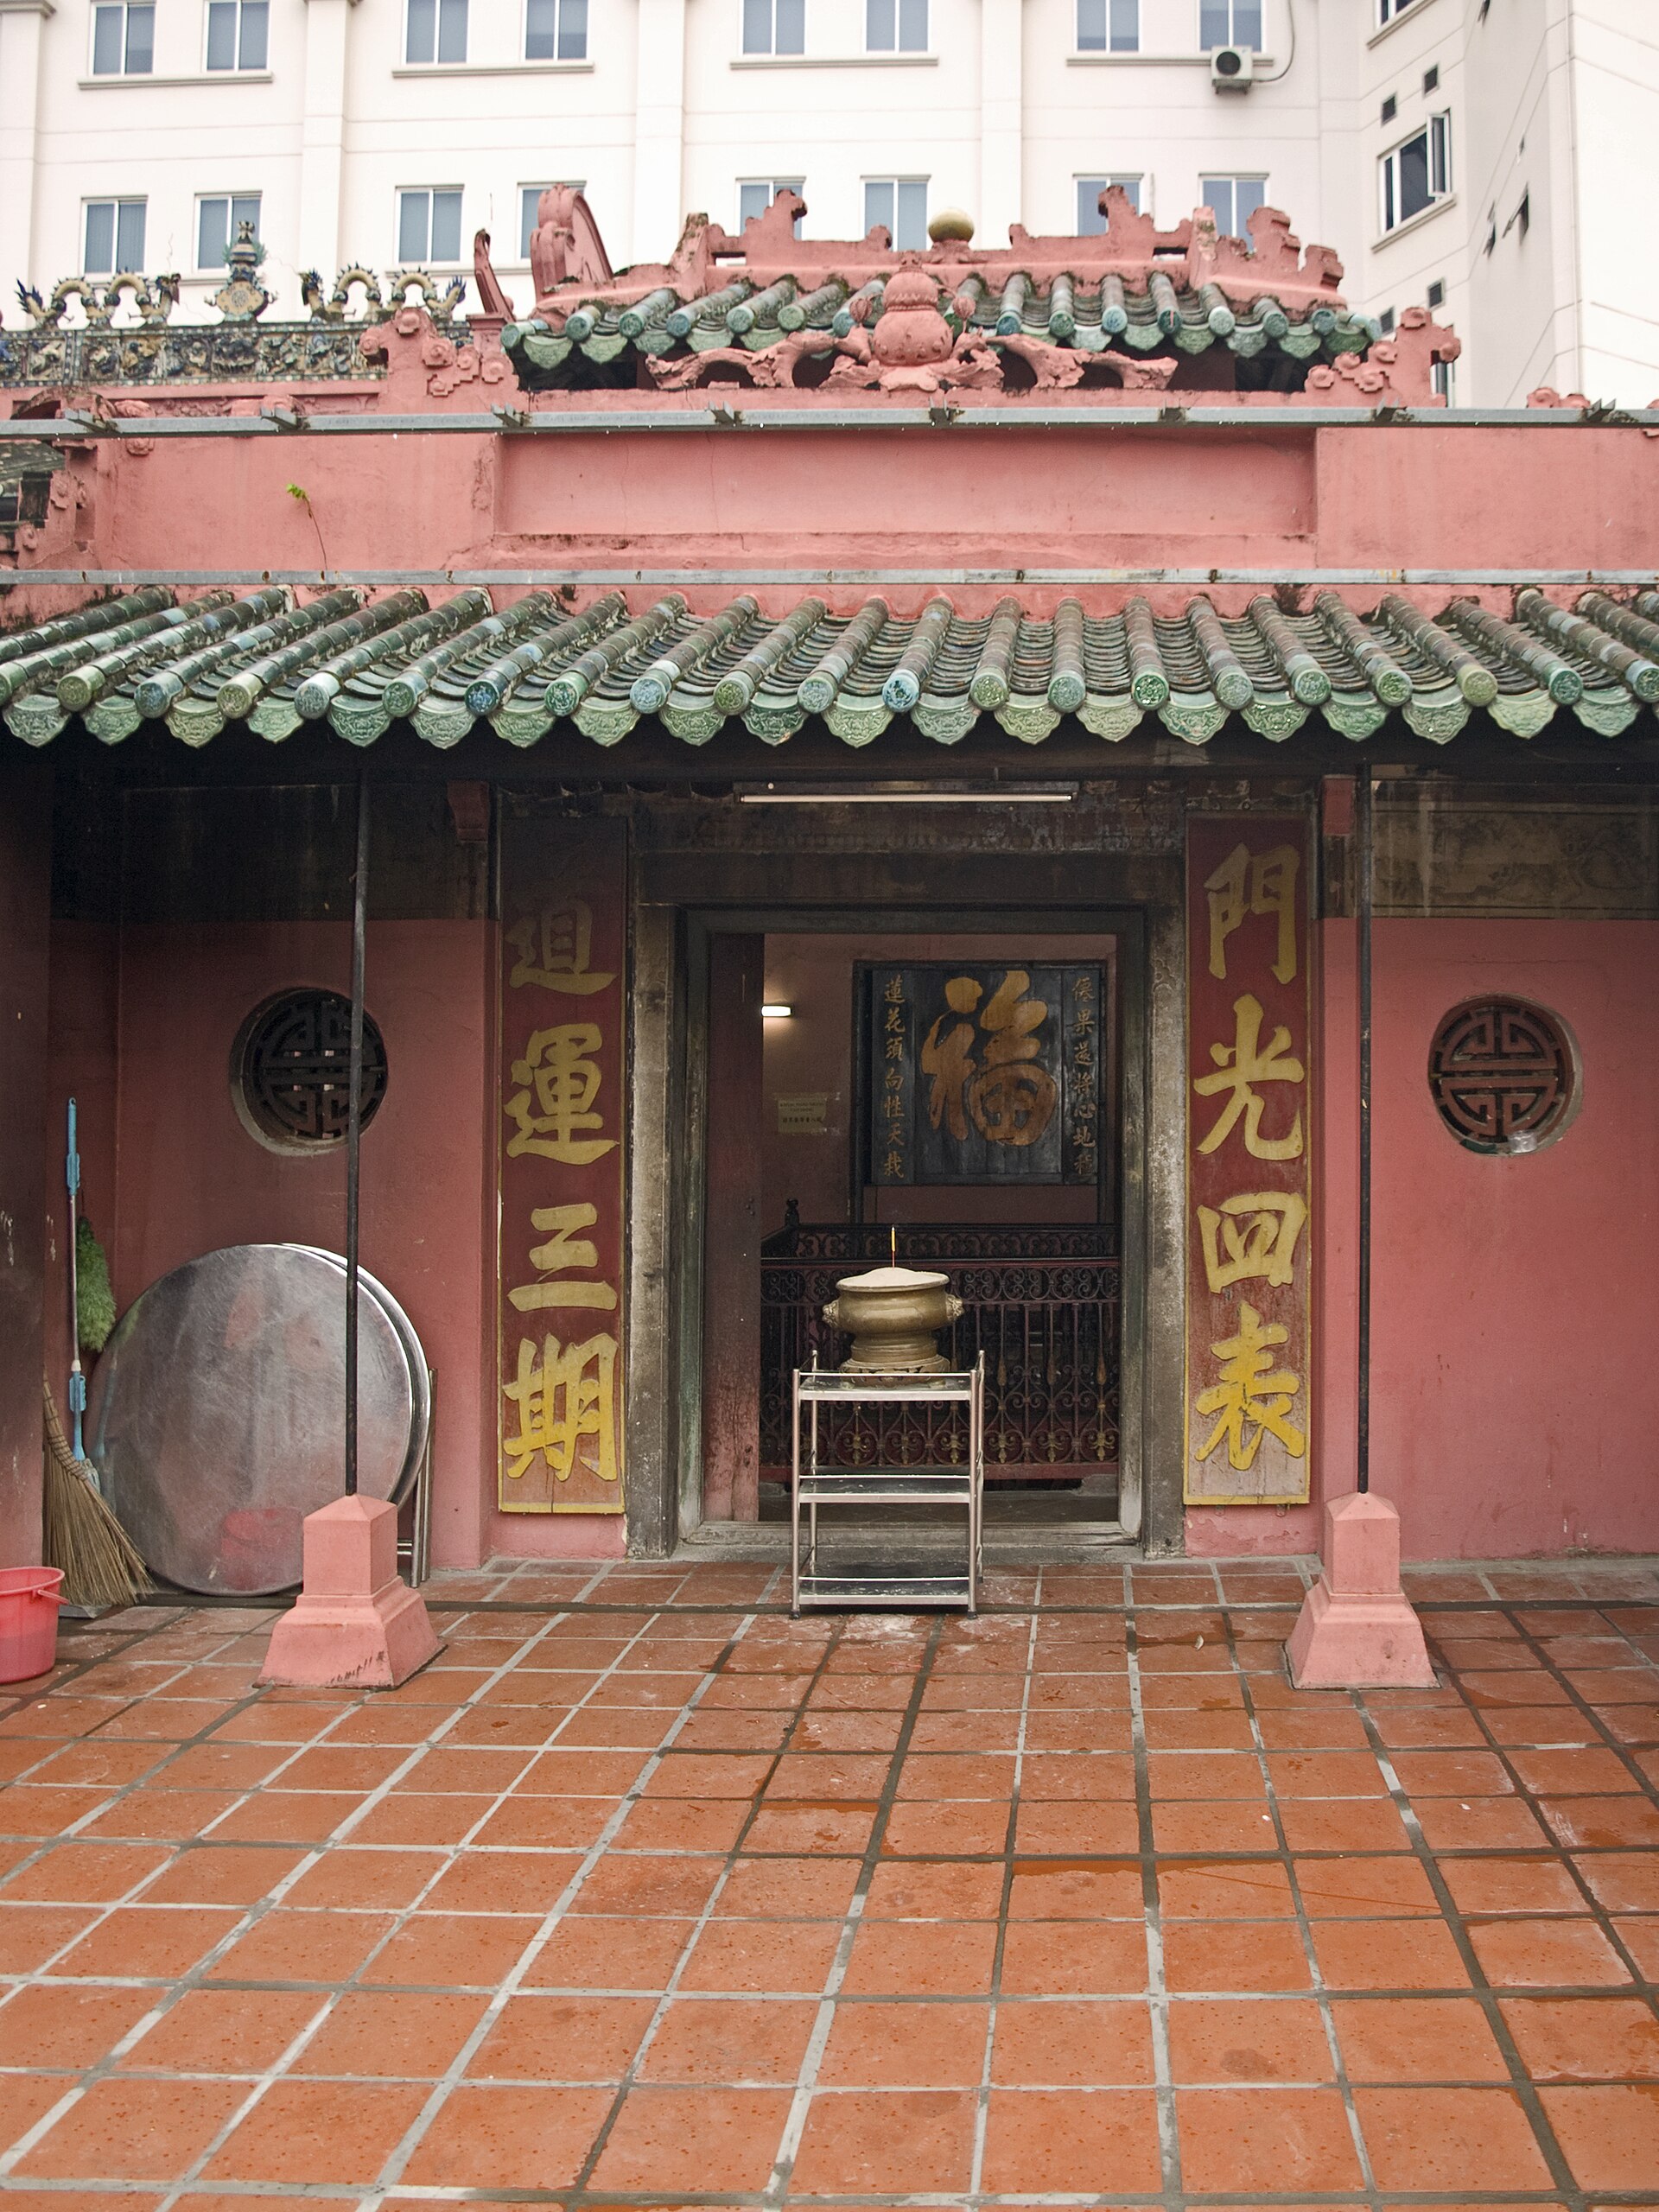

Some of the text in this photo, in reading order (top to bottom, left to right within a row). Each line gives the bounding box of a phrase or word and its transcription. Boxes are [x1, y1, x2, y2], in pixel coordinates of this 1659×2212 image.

[921, 969, 1058, 1147] 福
[1193, 842, 1307, 1471] 門光四表
